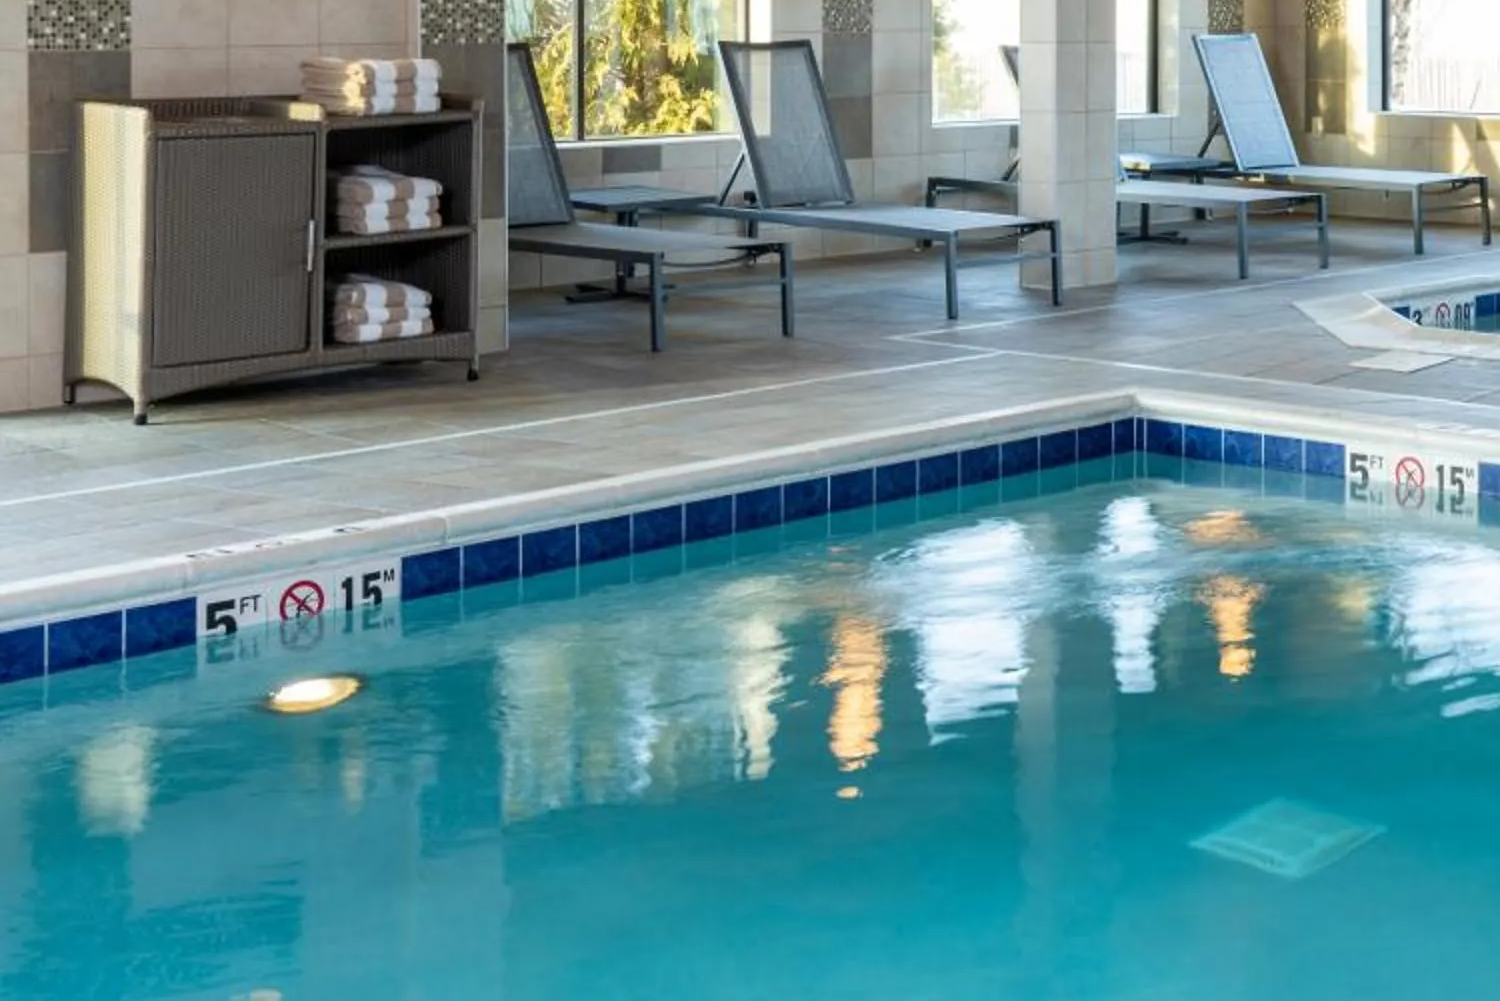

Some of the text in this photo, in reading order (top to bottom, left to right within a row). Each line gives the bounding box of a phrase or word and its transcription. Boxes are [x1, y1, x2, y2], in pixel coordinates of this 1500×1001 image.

[1350, 452, 1369, 489] 5
[1370, 455, 1384, 469] FT
[205, 599, 238, 636] 5
[240, 594, 262, 615] FT
